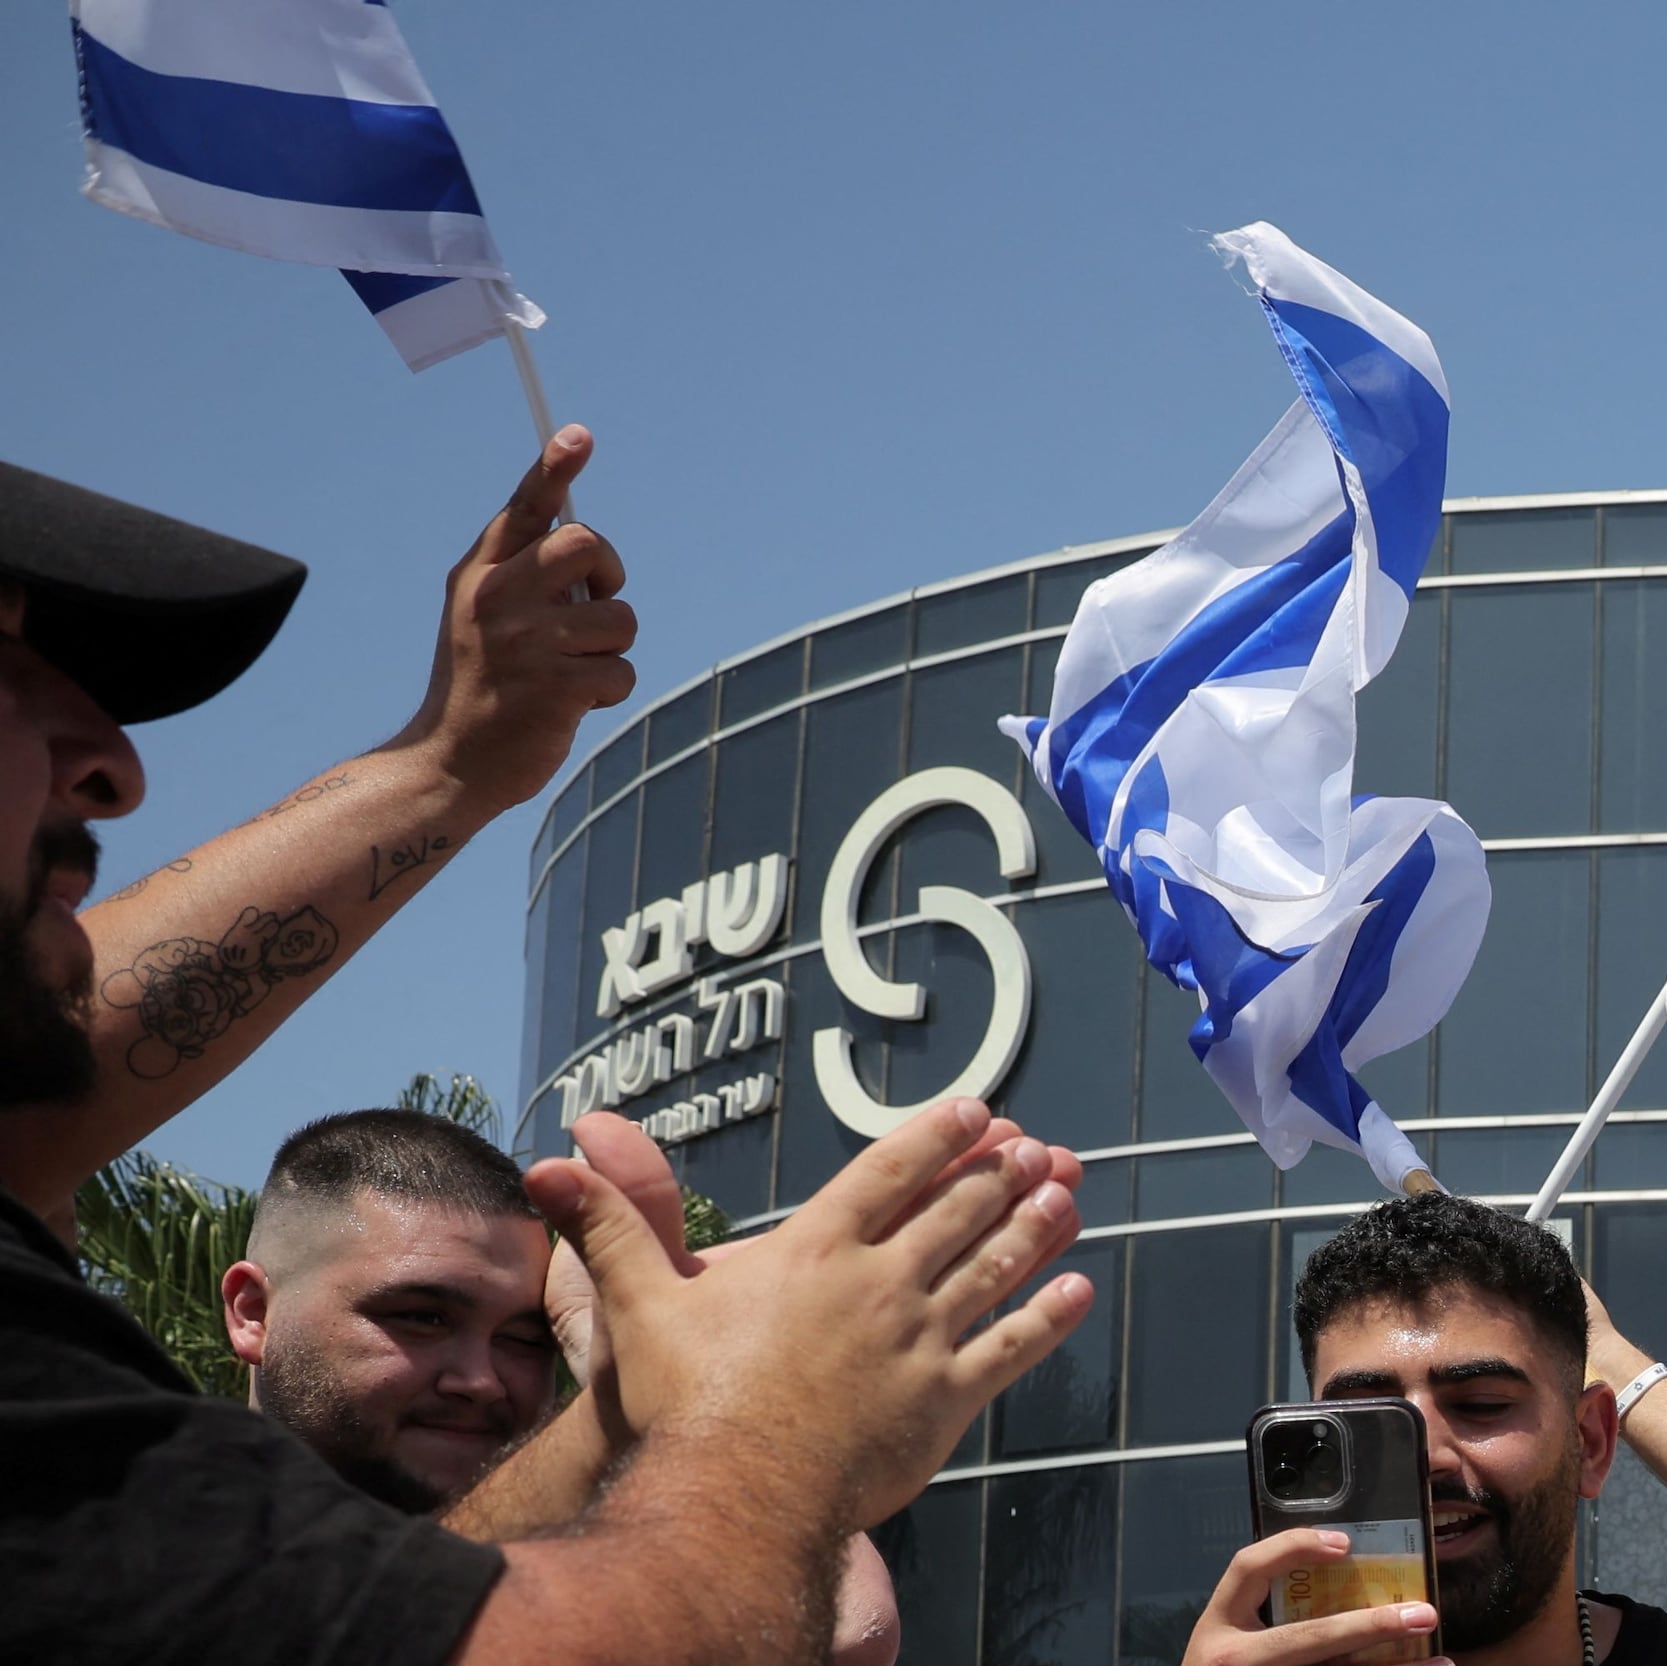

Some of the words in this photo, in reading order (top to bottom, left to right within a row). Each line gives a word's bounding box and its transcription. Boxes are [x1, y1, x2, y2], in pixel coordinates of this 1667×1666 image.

[596, 852, 788, 1018] שיבא
[698, 977, 784, 1059] תל
[553, 1012, 694, 1129] השומר
[716, 1072, 774, 1119] עיר
